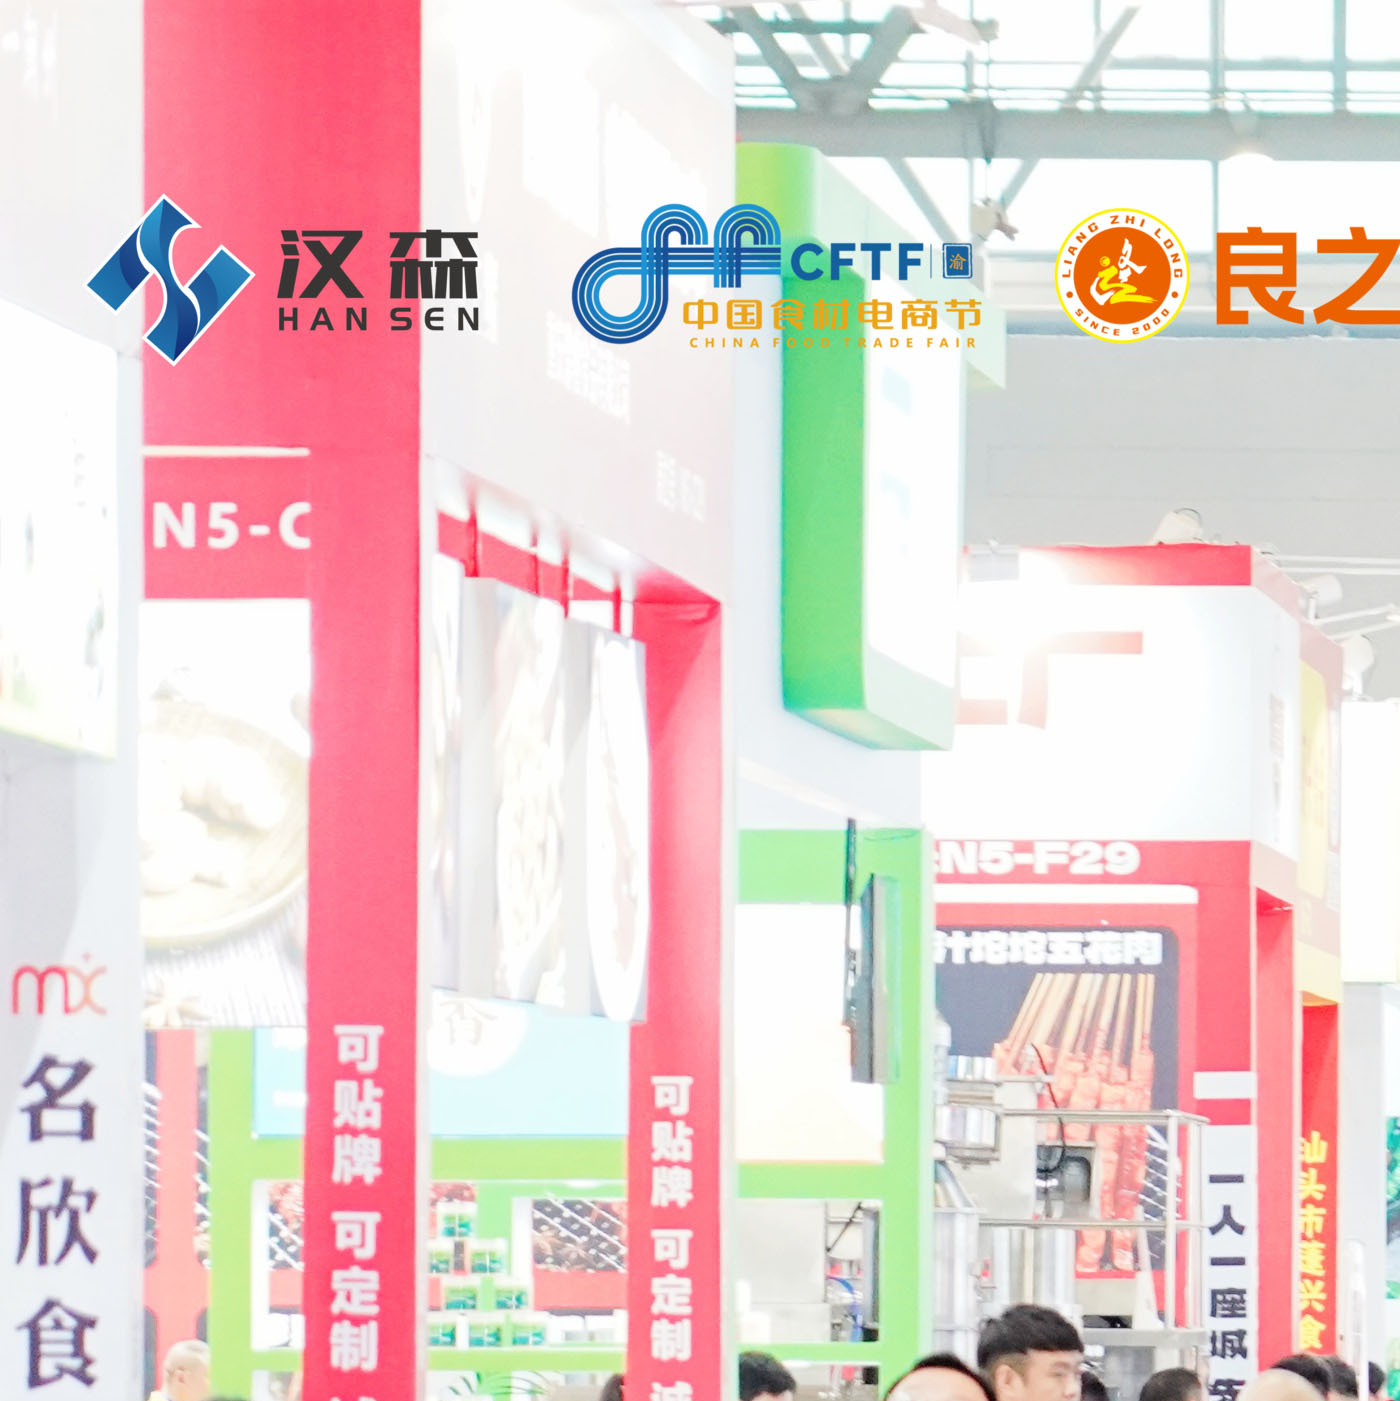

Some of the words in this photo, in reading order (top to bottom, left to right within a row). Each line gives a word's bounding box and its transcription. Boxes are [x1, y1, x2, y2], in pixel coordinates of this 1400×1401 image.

[332, 1024, 385, 1186] 可贴牌
[651, 1075, 694, 1209] 可贴牌
[330, 1211, 382, 1372] 可定制
[650, 1228, 693, 1361] 可定制
